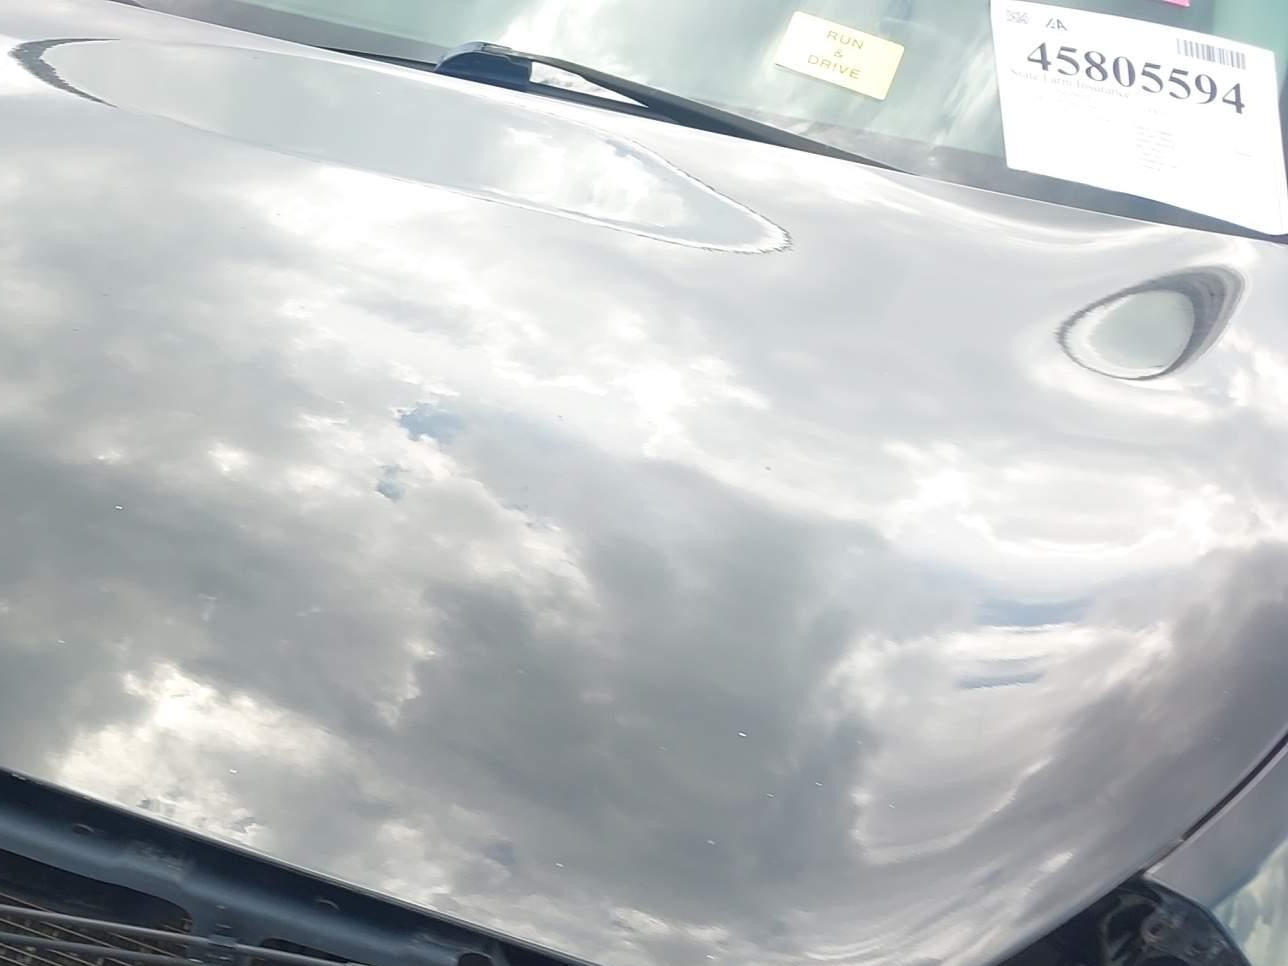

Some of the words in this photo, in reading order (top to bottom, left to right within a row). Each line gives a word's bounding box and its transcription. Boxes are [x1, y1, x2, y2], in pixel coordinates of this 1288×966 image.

[826, 30, 865, 49] RUN
[834, 48, 844, 58] &
[807, 54, 862, 80] DRIVE
[1027, 41, 1246, 114] 45805594
